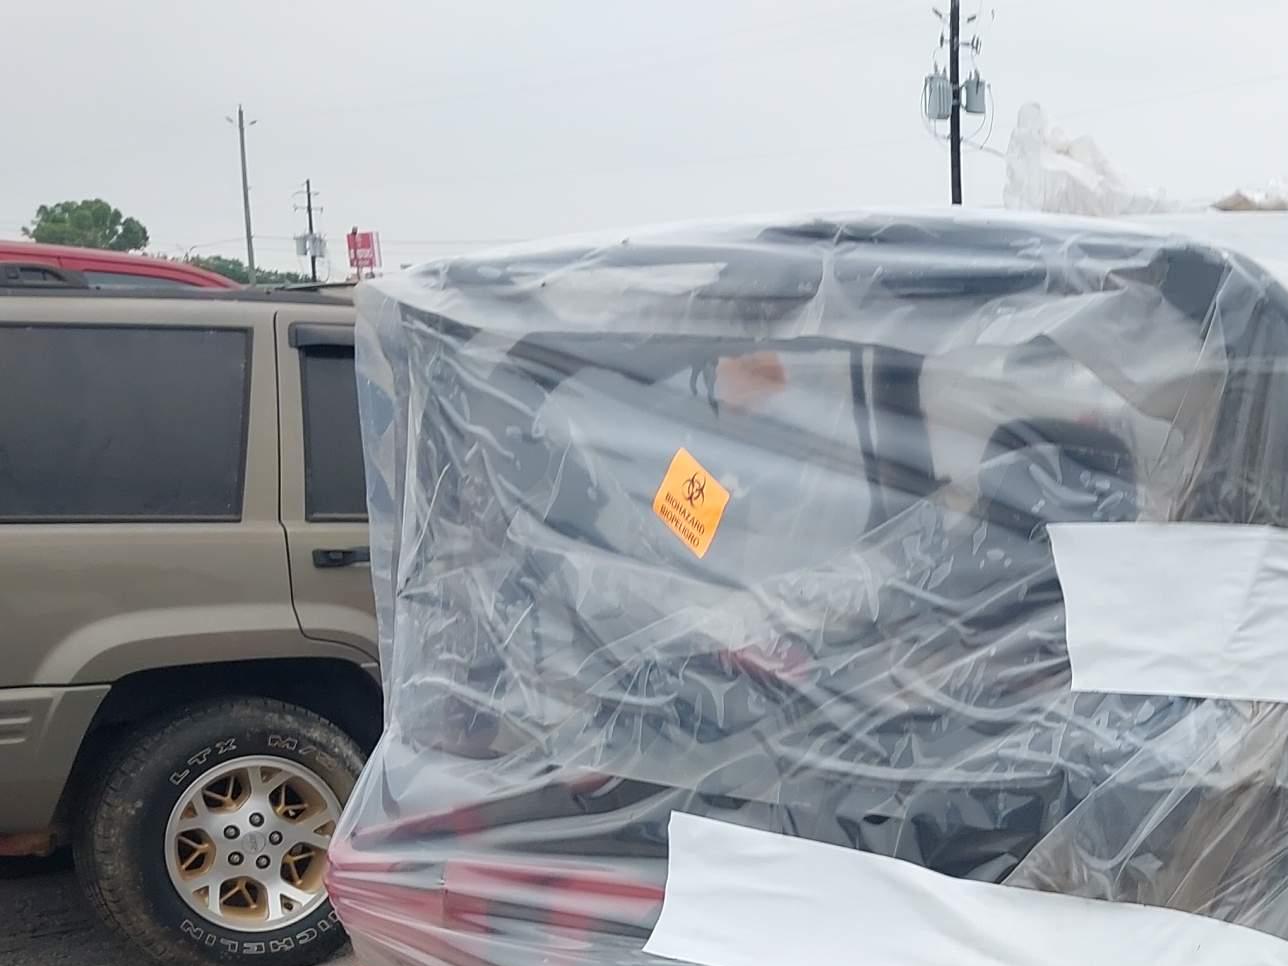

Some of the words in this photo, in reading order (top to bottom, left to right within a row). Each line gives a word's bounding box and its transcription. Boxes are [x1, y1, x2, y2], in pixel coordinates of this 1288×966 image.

[660, 503, 700, 547] BIOPELIGRO
[665, 492, 705, 536] BIOHAZARD
[169, 738, 237, 785] LTX
